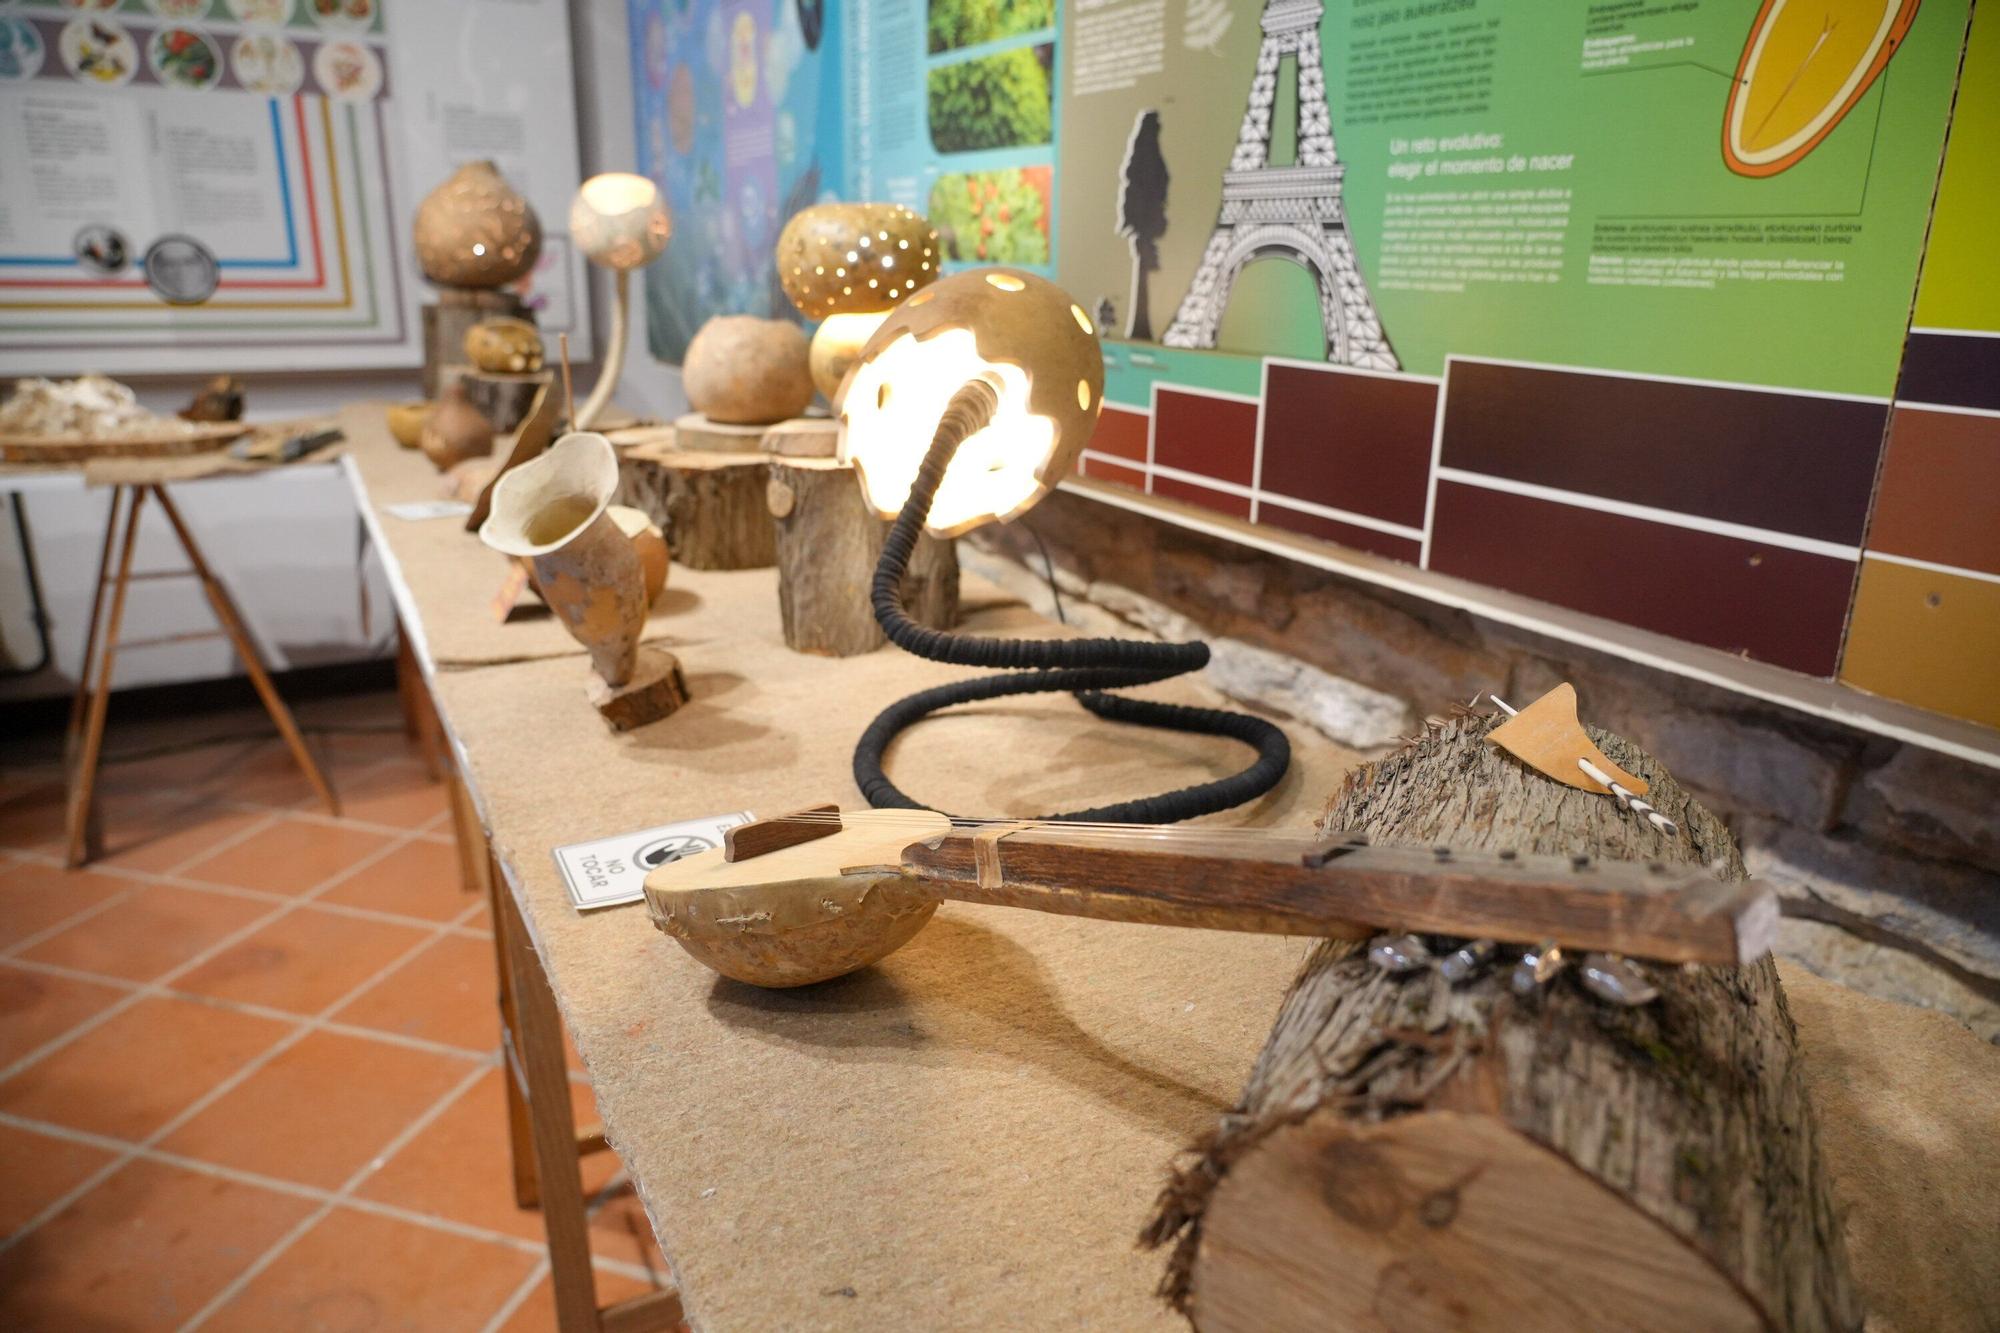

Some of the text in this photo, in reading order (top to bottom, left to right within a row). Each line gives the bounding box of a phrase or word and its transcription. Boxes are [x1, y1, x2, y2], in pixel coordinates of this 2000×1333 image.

[1390, 132, 1504, 155] Un reto evolutivo:
[1388, 154, 1574, 181] elegir el momento de nacer
[580, 854, 608, 888] TOCAR
[605, 858, 626, 874] NO
